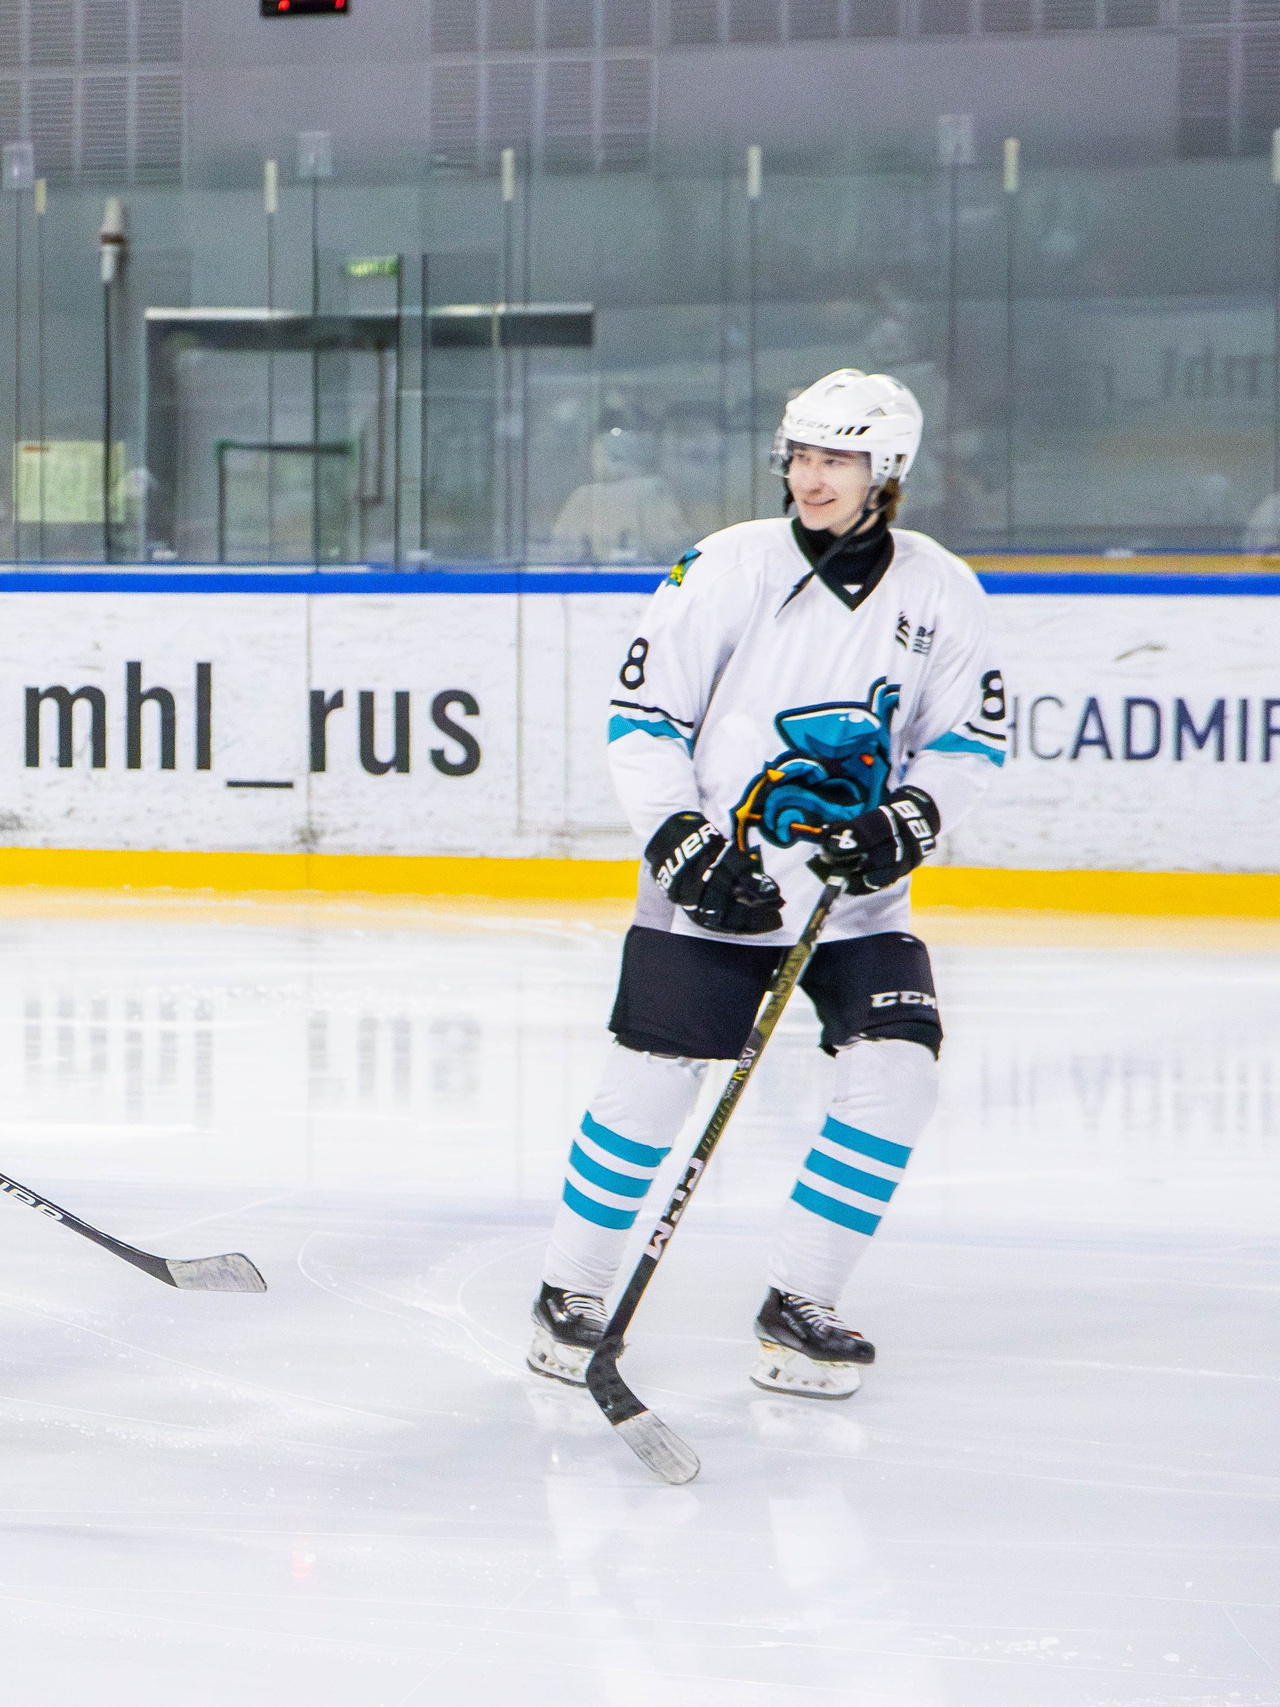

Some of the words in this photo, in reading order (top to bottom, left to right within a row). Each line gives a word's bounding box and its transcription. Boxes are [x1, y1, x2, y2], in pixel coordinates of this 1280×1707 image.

[619, 636, 649, 690] 8
[980, 669, 1006, 721] 8
[655, 822, 720, 893] AUER
